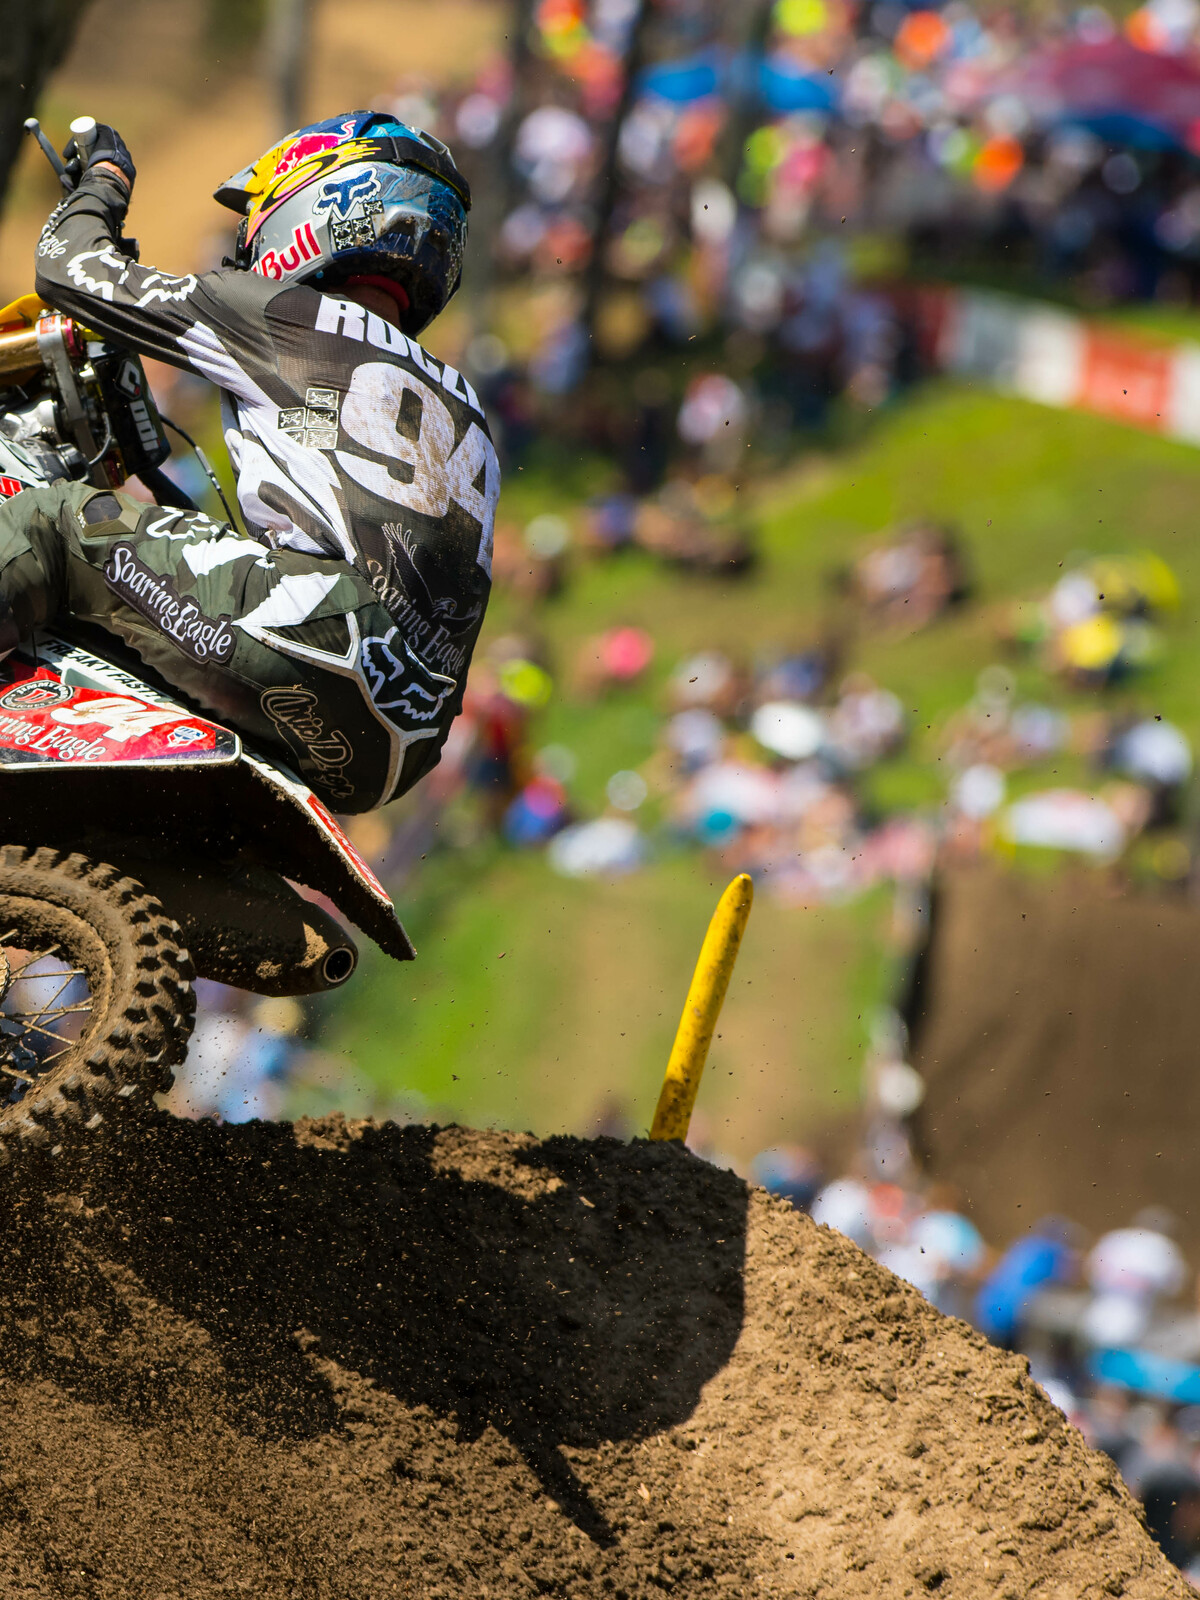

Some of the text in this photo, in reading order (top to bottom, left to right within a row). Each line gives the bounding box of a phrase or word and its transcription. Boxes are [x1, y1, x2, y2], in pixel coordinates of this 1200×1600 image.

[261, 223, 322, 280] Bull
[334, 362, 502, 581] 94
[106, 548, 232, 656] Soaring Eagle
[366, 559, 467, 676] Soaring Eagle
[38, 640, 117, 671] FREAKY
[29, 724, 107, 761] Eagle
[51, 697, 194, 743] 94
